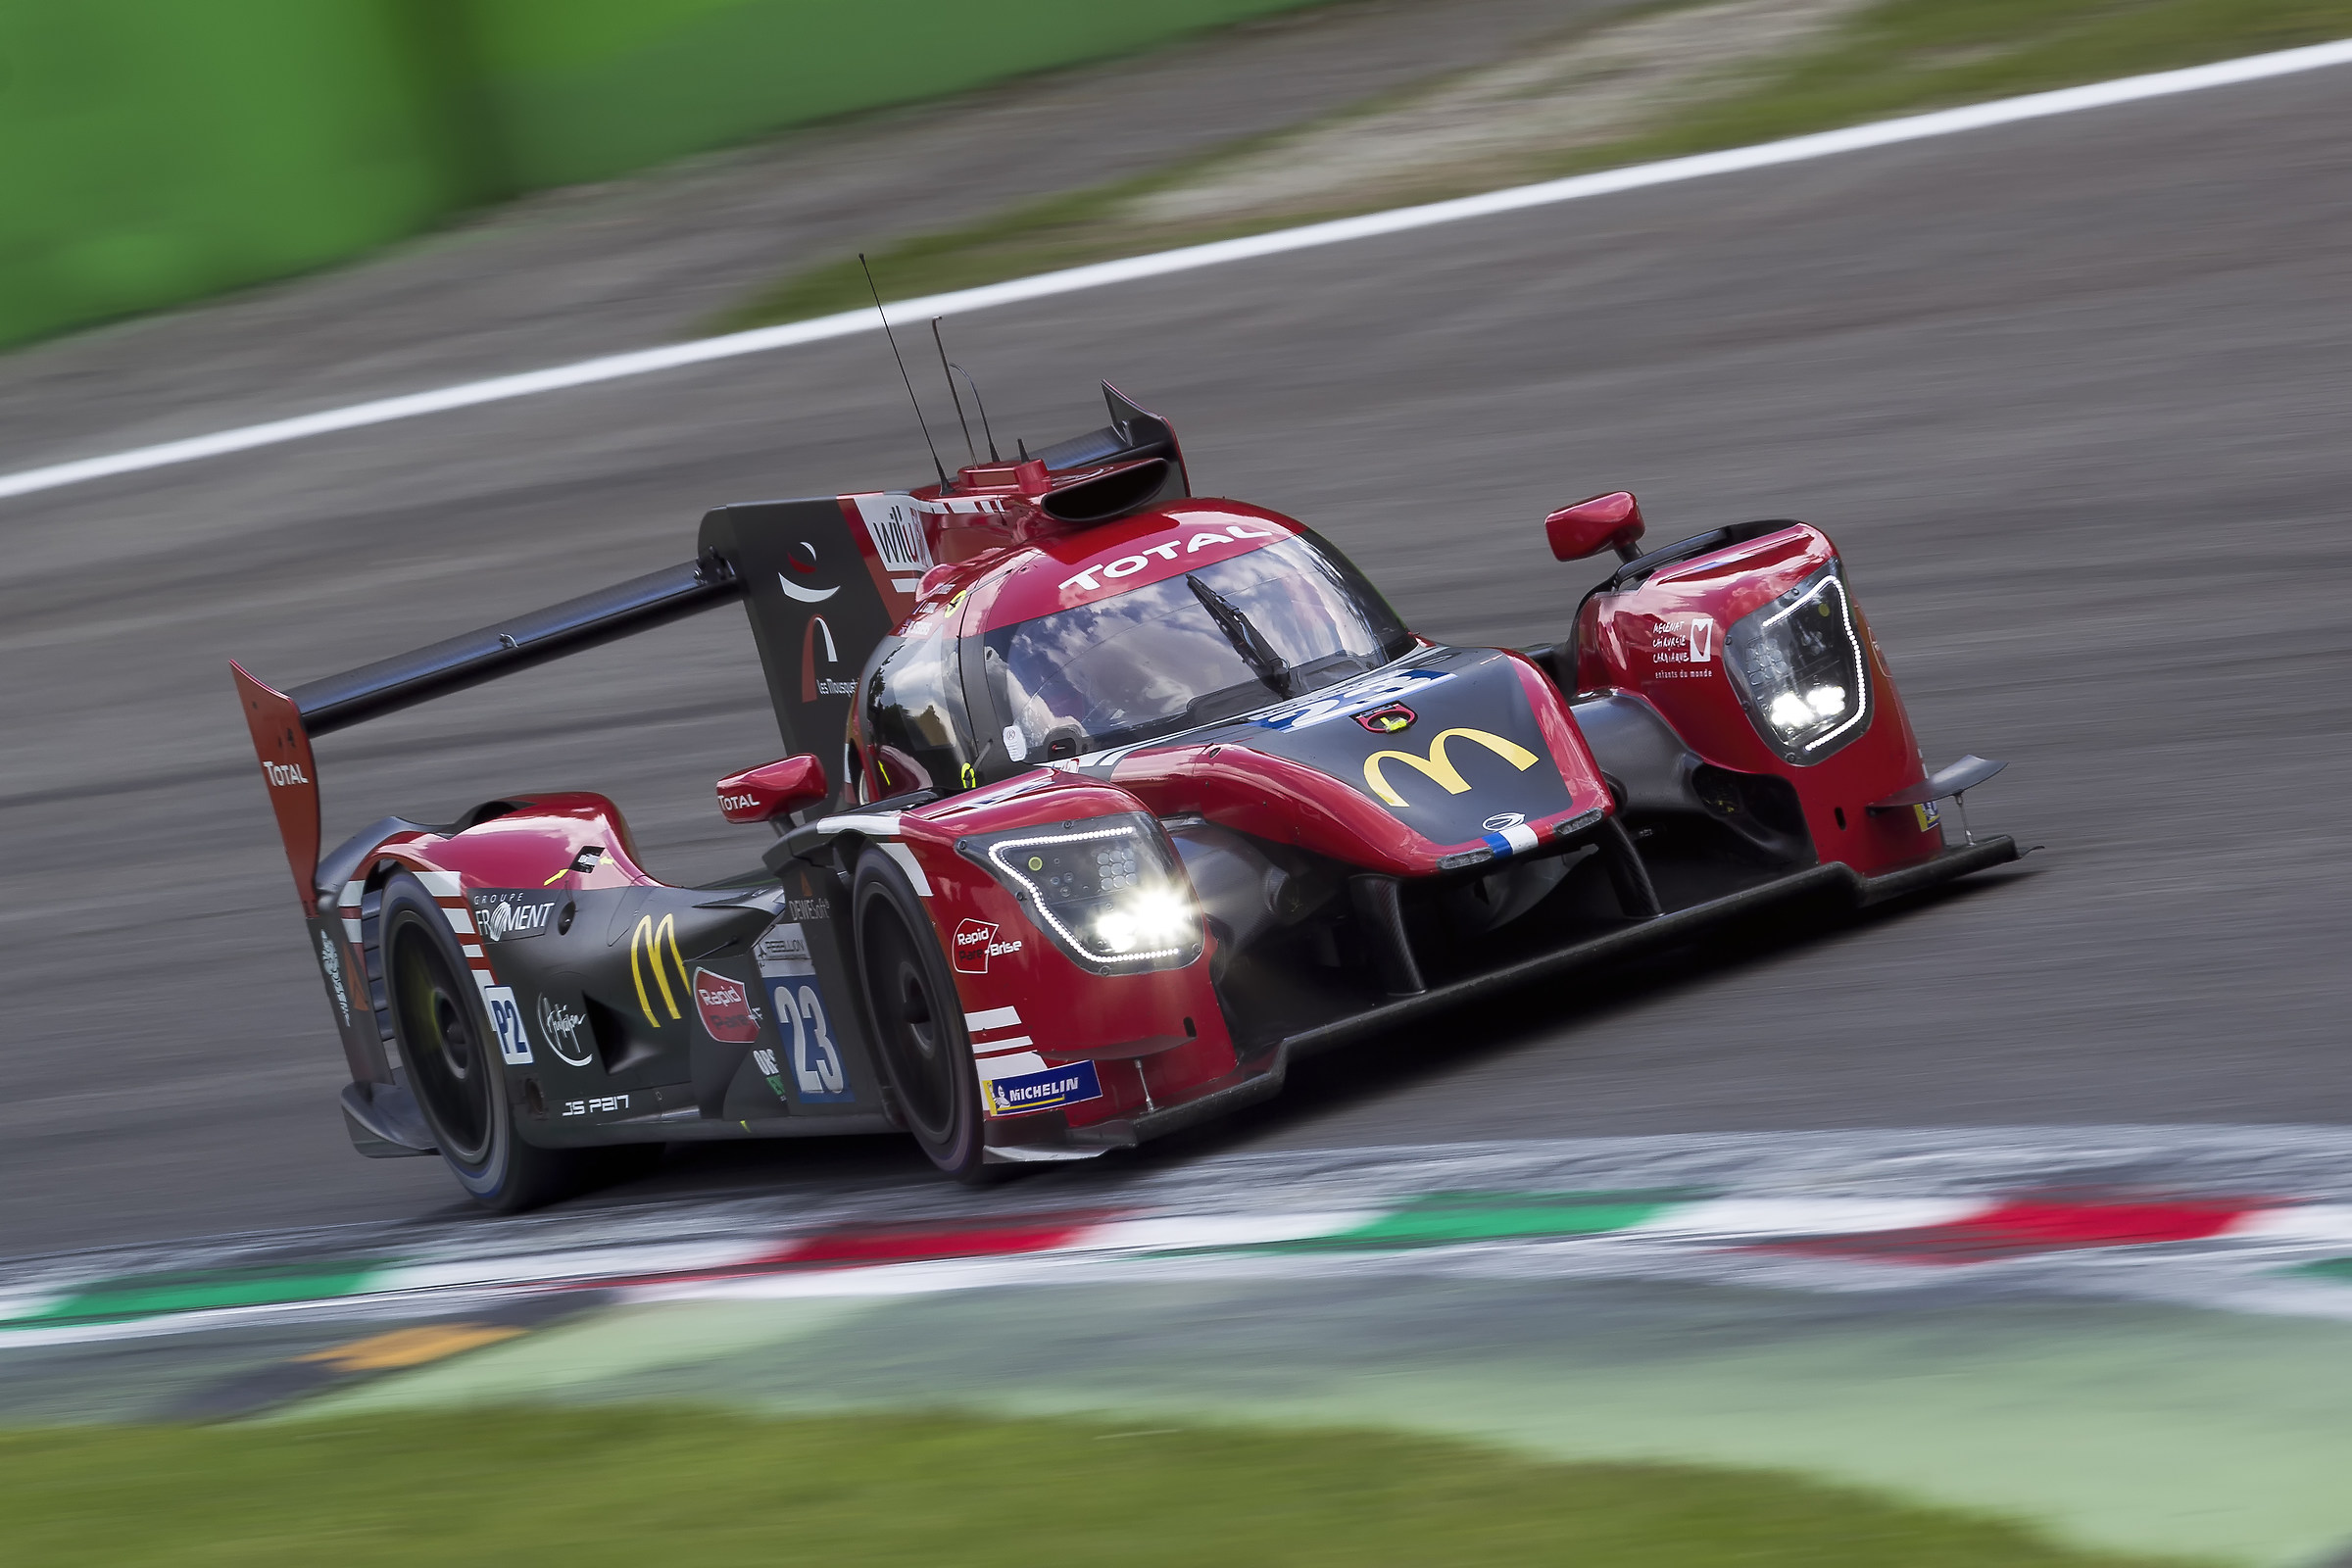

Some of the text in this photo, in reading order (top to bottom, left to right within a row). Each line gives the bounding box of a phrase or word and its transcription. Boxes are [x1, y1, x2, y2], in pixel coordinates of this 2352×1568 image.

[1058, 525, 1273, 591] TOTAL
[1654, 667, 1713, 679] enfants du monde
[262, 760, 310, 787] TOTAL
[717, 793, 760, 811] TOTAL
[473, 892, 524, 906] GROUPE
[956, 927, 990, 946] Rapid
[698, 985, 743, 1007] Rapid
[490, 1000, 529, 1054] P2
[773, 984, 845, 1094] 23
[1008, 1076, 1080, 1102] MICHELIN
[562, 1094, 629, 1116] JS P217
